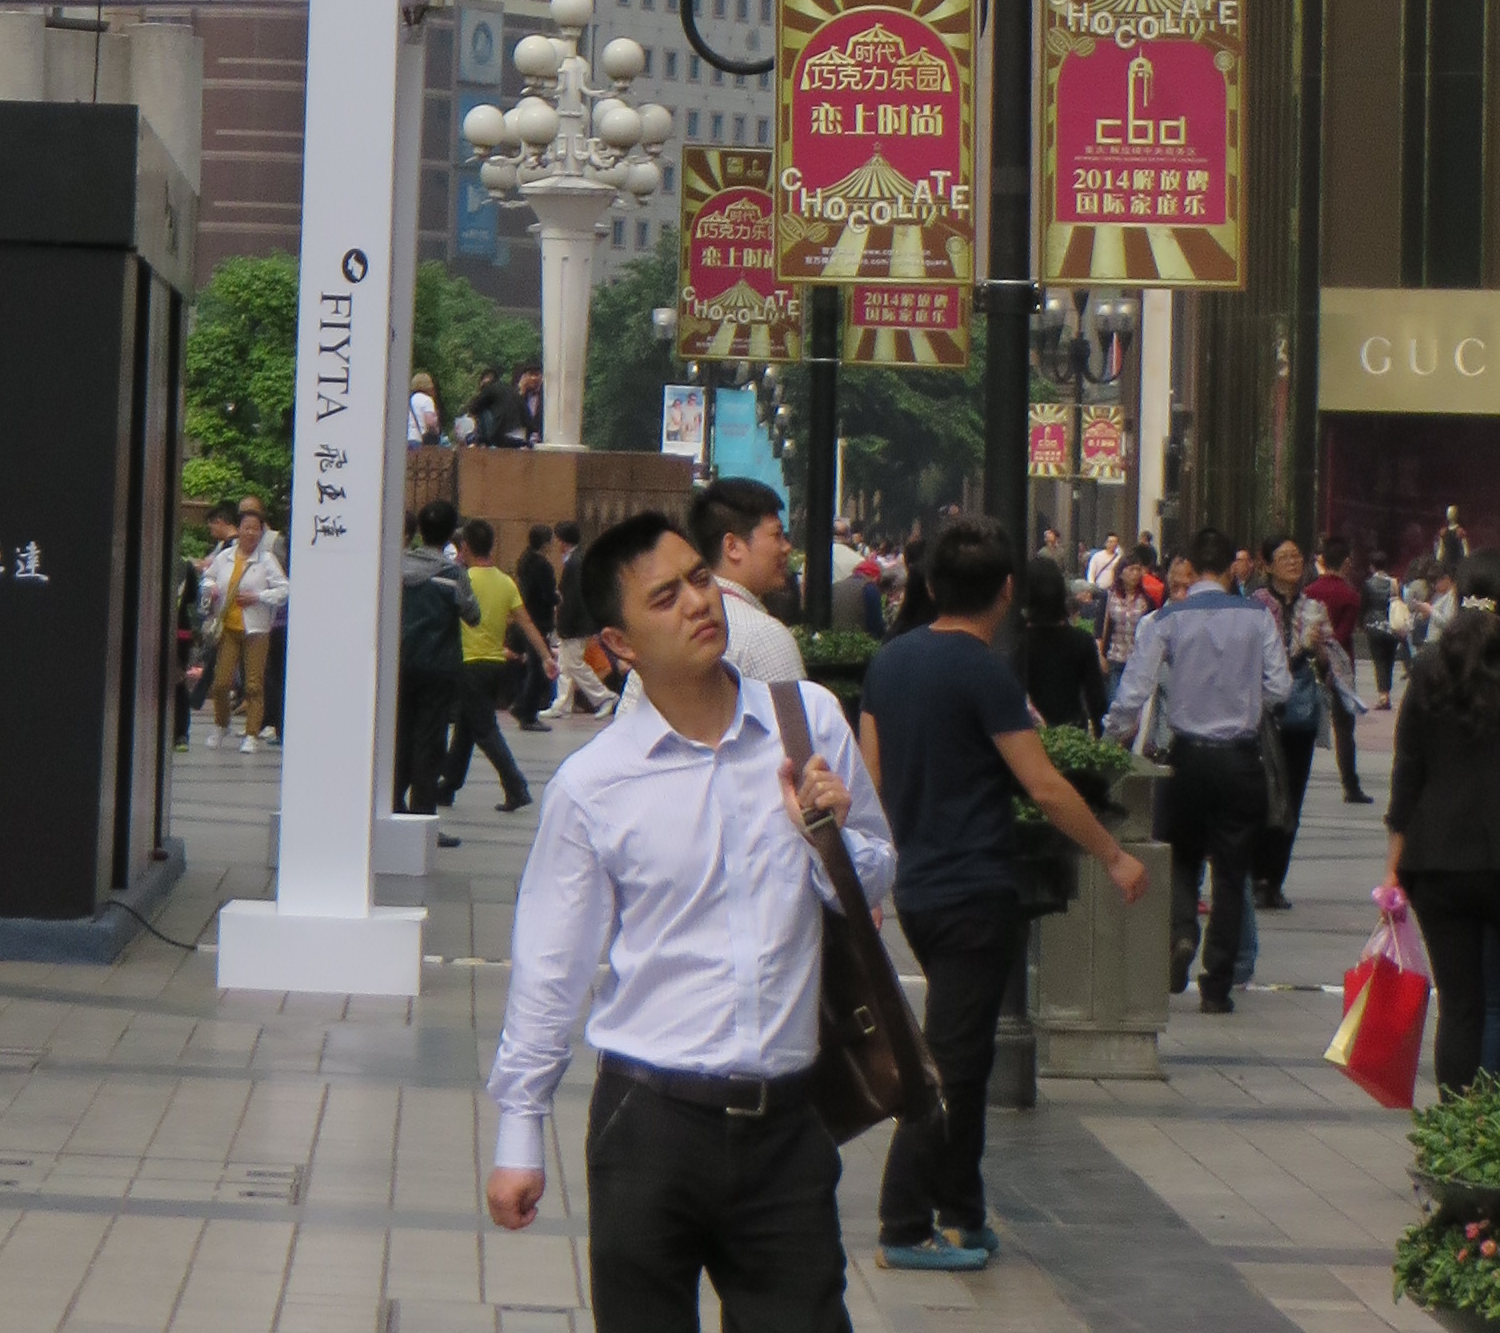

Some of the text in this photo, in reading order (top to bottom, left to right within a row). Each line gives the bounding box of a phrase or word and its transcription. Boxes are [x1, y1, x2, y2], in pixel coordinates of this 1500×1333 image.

[855, 44, 896, 64] 时代
[811, 66, 941, 91] 巧克力乐园
[810, 102, 944, 137] 恋上时尚
[780, 167, 970, 233] CHOCOLATE
[1075, 193, 1207, 216] 国际家庭乐
[682, 285, 801, 326] CHOCOLATE
[315, 291, 353, 423] FIYTA
